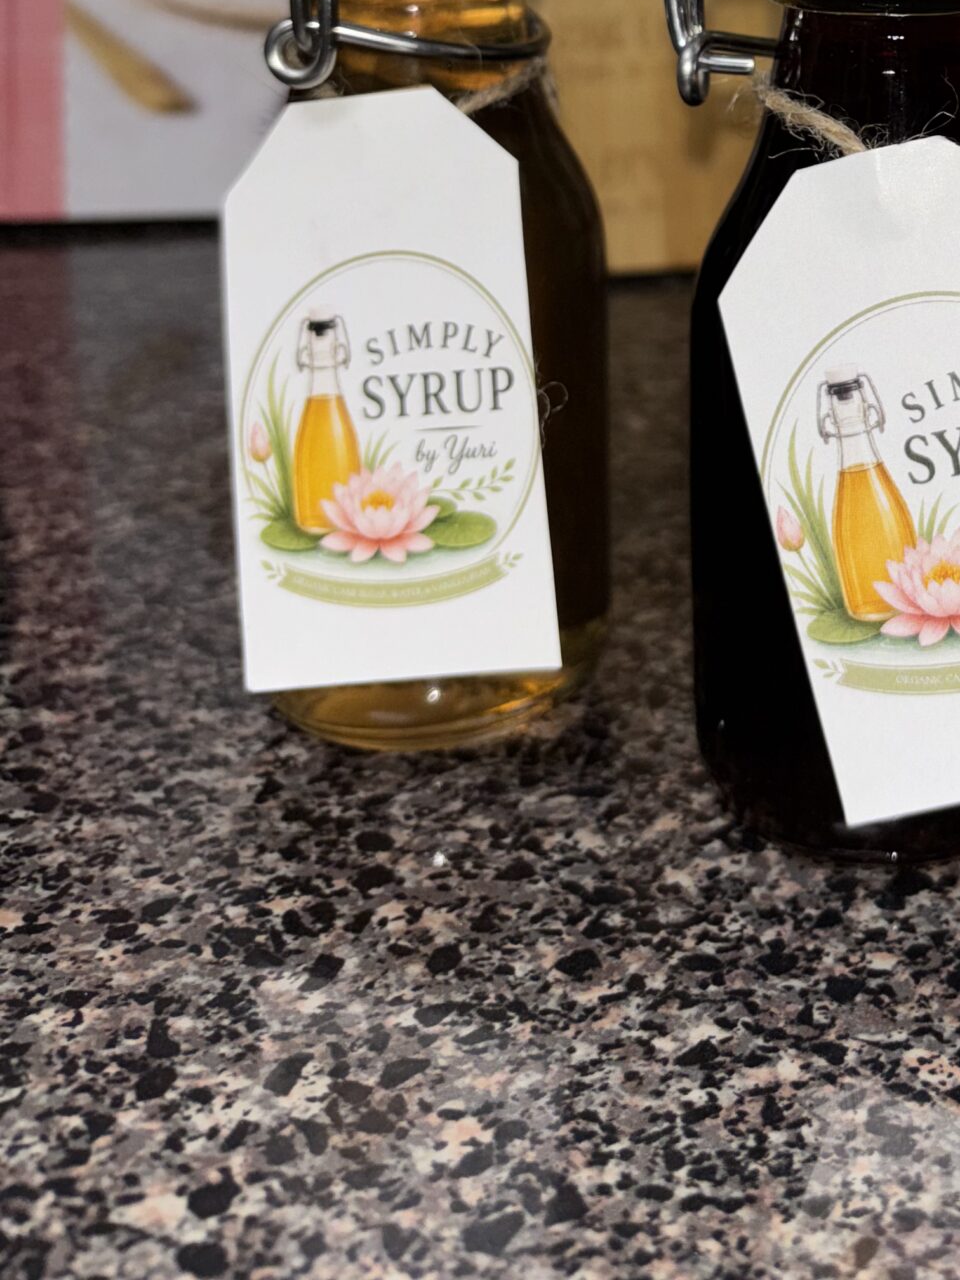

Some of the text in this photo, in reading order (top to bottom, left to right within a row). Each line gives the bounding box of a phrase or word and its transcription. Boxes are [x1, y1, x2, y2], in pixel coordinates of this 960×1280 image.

[365, 321, 505, 366] SIMPLY
[362, 366, 515, 420] SYRUP
[415, 434, 498, 475] by Yuri
